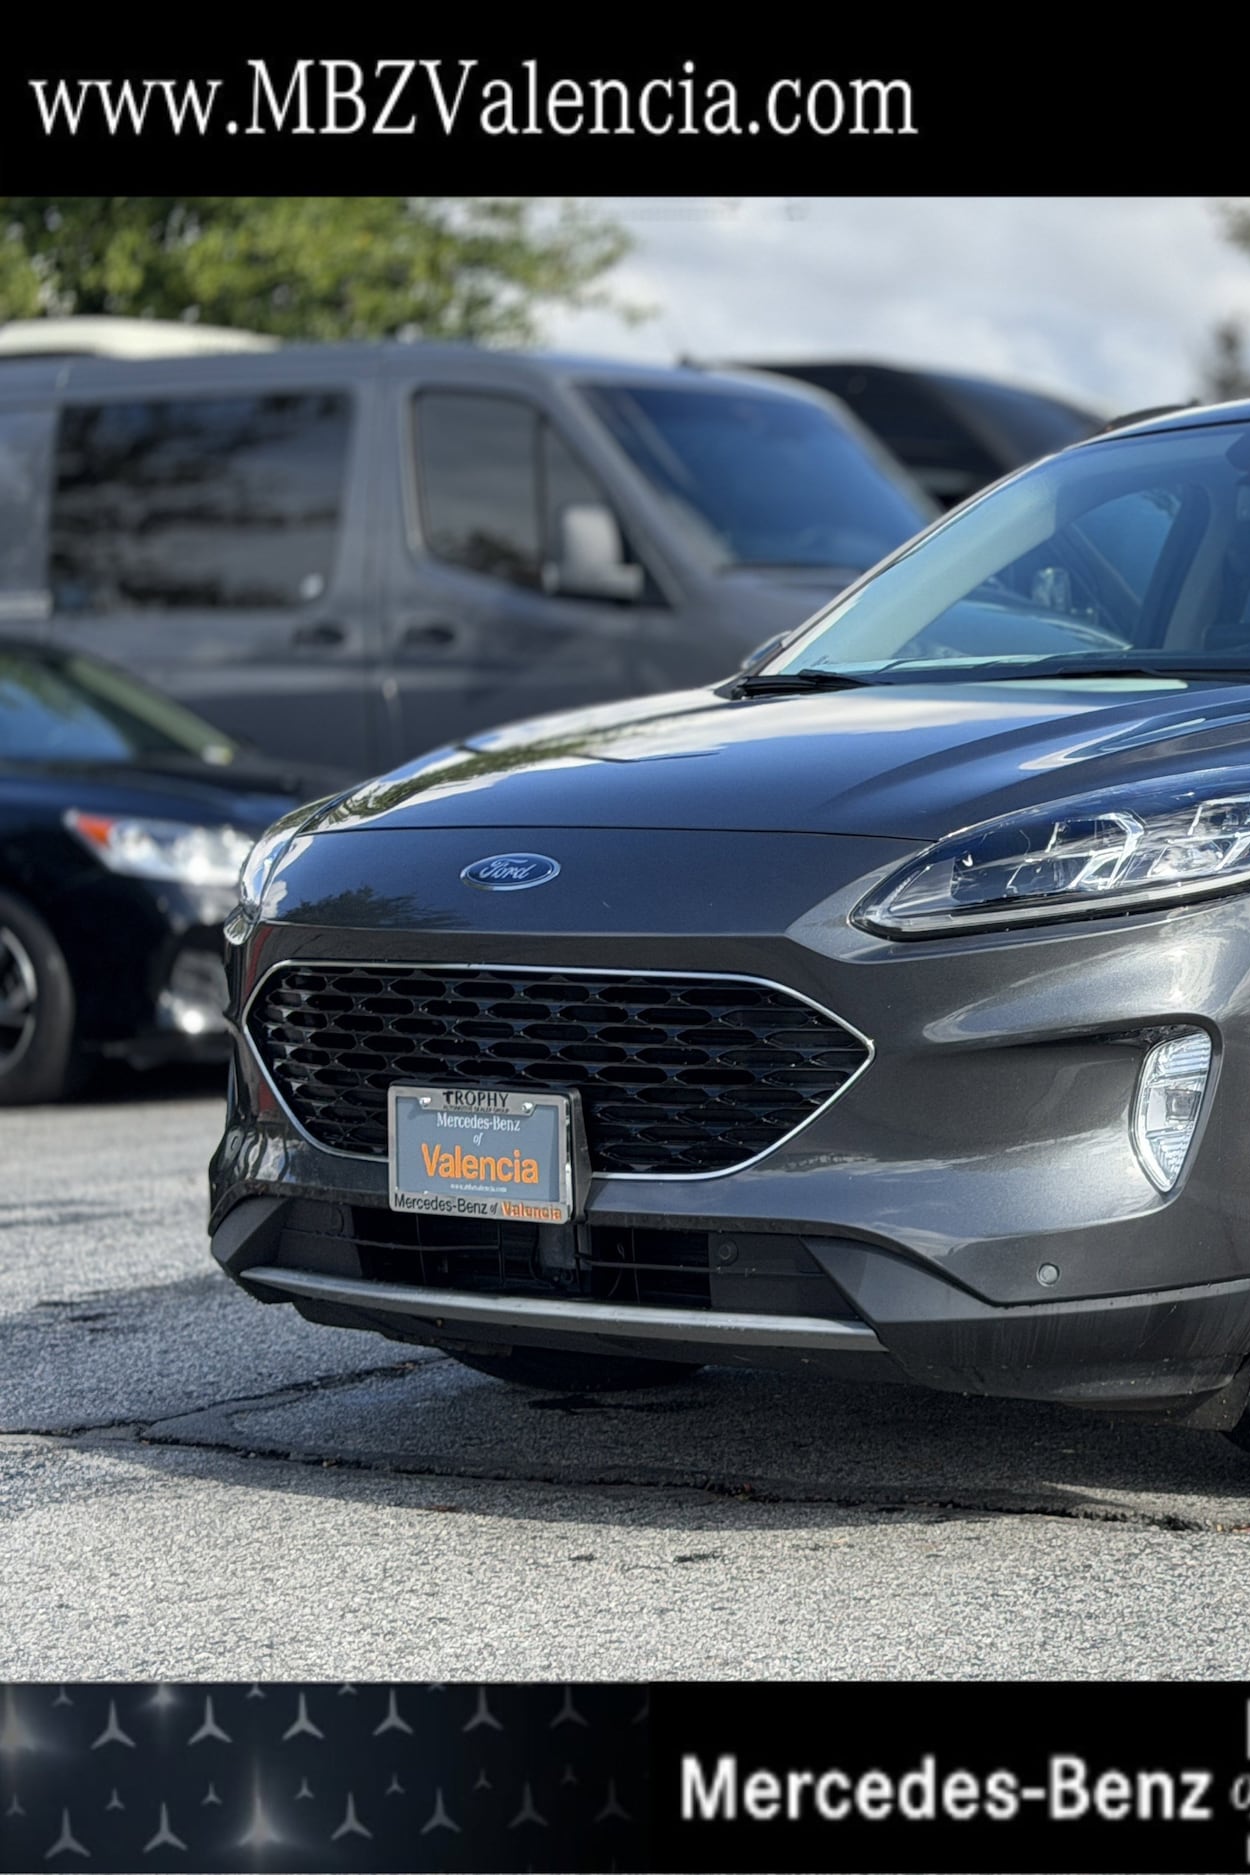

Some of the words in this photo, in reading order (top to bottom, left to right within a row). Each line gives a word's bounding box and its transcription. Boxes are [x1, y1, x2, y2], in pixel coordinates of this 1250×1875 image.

[480, 858, 536, 879] Ford
[443, 1090, 509, 1107] TROPHY
[437, 1113, 520, 1131] Mercedes-Benz
[473, 1132, 484, 1146] of
[421, 1143, 539, 1184] Valencia
[394, 1194, 489, 1215] Mercedes-Benz
[490, 1203, 498, 1215] of
[501, 1202, 562, 1220] Valencia
